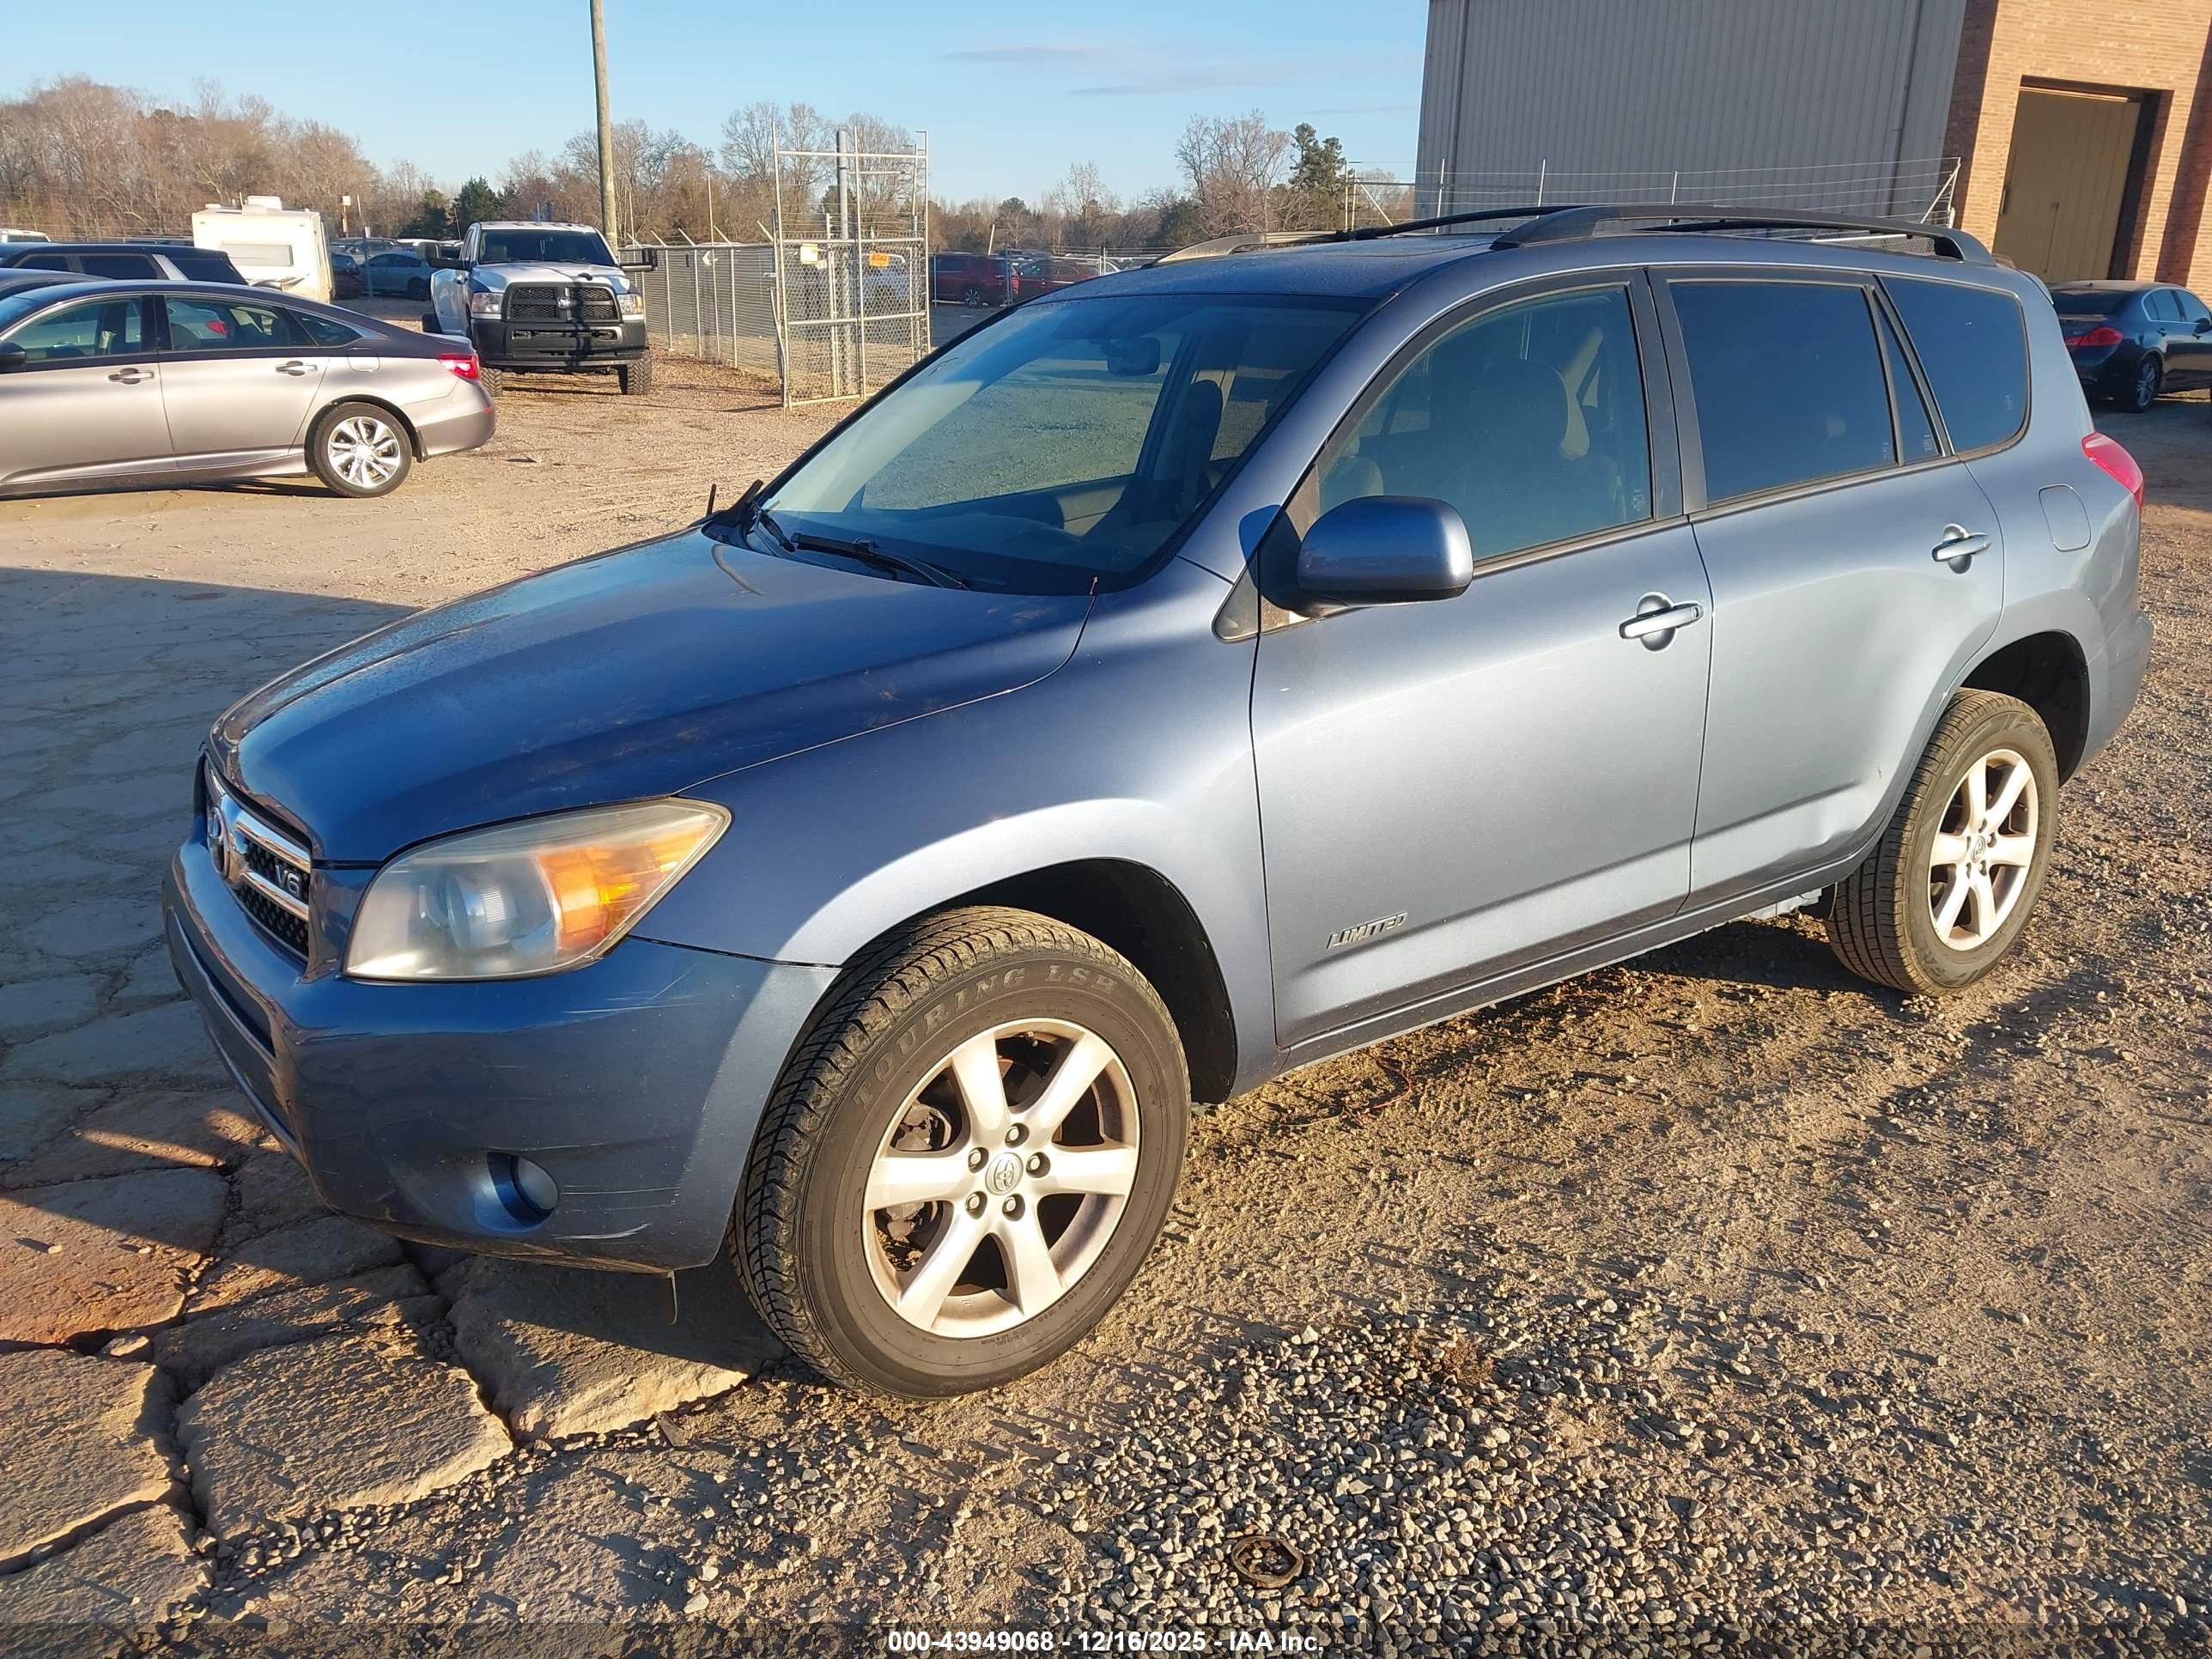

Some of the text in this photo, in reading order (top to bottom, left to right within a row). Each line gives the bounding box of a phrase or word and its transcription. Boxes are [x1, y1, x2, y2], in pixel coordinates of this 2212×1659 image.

[275, 864, 300, 897] V6
[1325, 911, 1408, 951] LIMITED
[852, 967, 1026, 1110] TOURING
